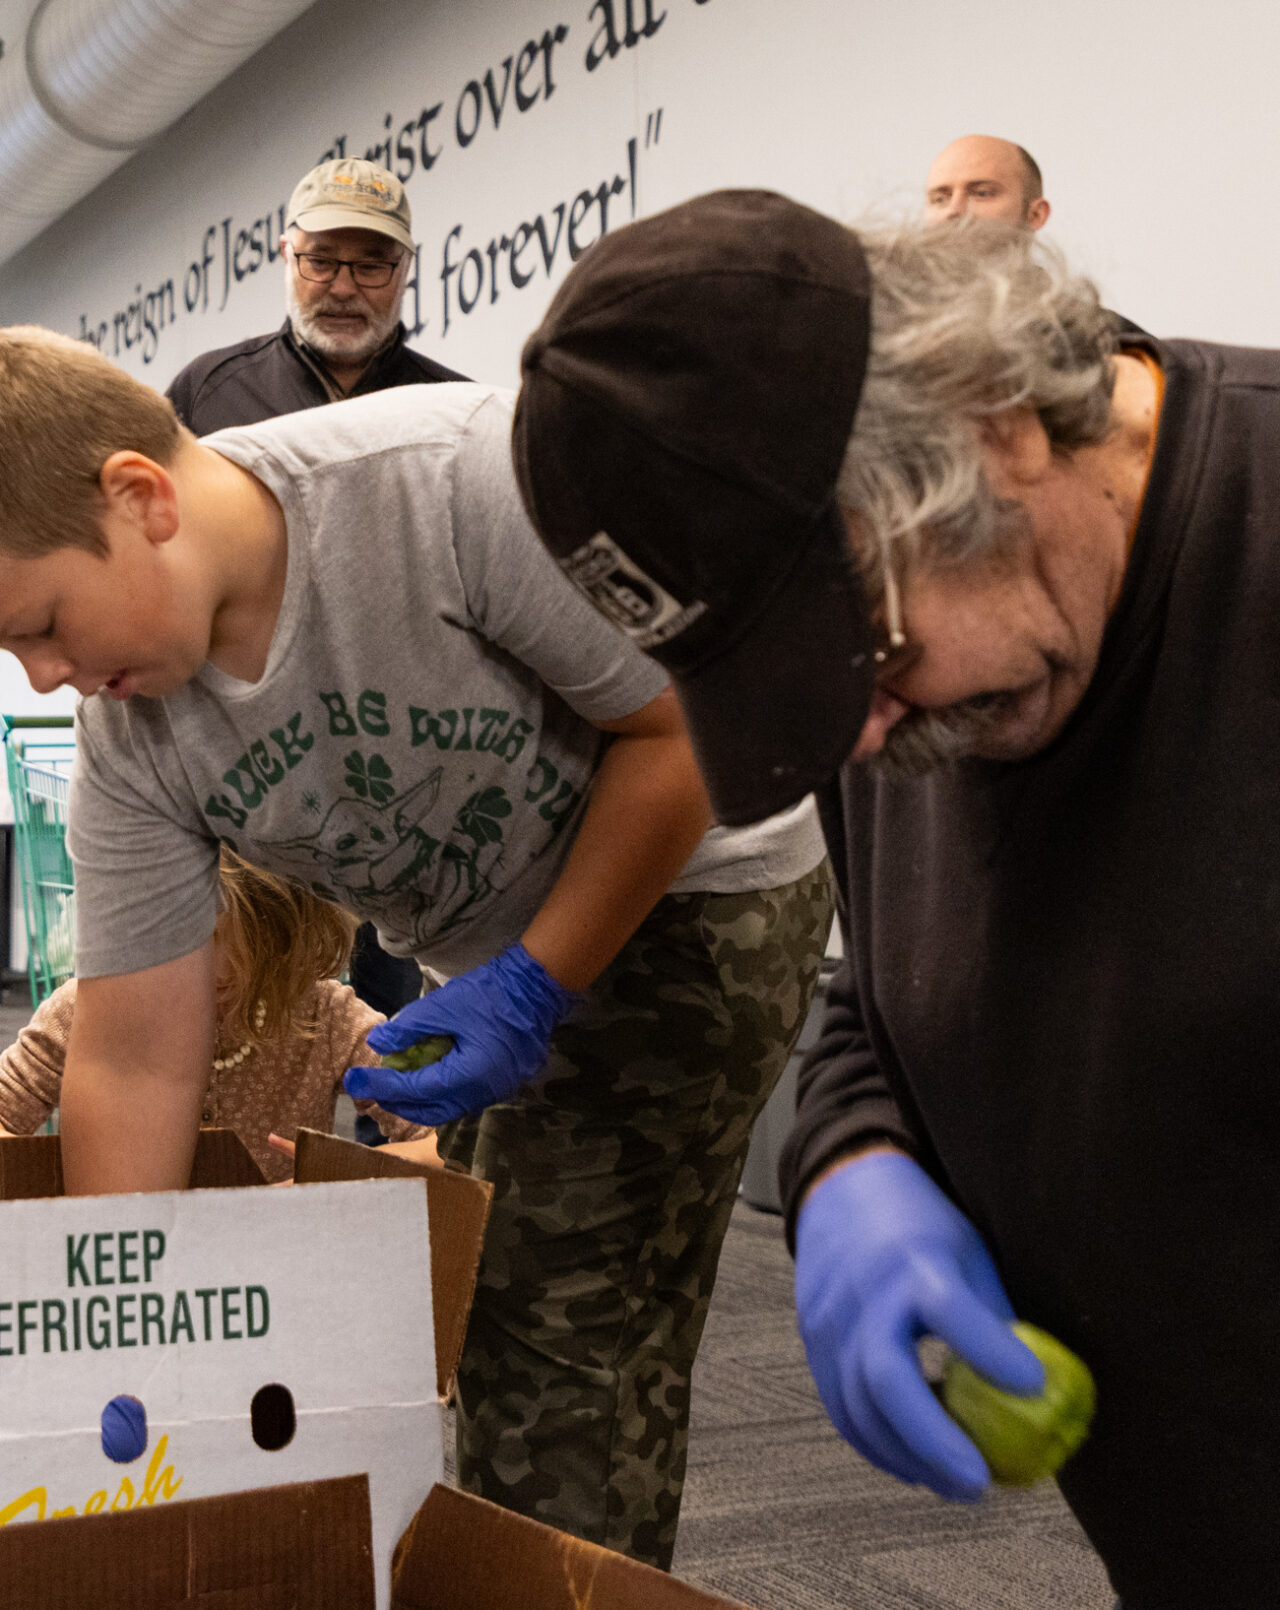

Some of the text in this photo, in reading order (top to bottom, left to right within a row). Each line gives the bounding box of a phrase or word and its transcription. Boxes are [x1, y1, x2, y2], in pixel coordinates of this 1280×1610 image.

[114, 279, 175, 365] reign
[184, 225, 215, 315] of
[220, 204, 295, 313] Jesu
[455, 22, 568, 148] over
[320, 689, 391, 737] BE
[408, 705, 535, 764] WITH
[65, 1228, 167, 1288] KEEP
